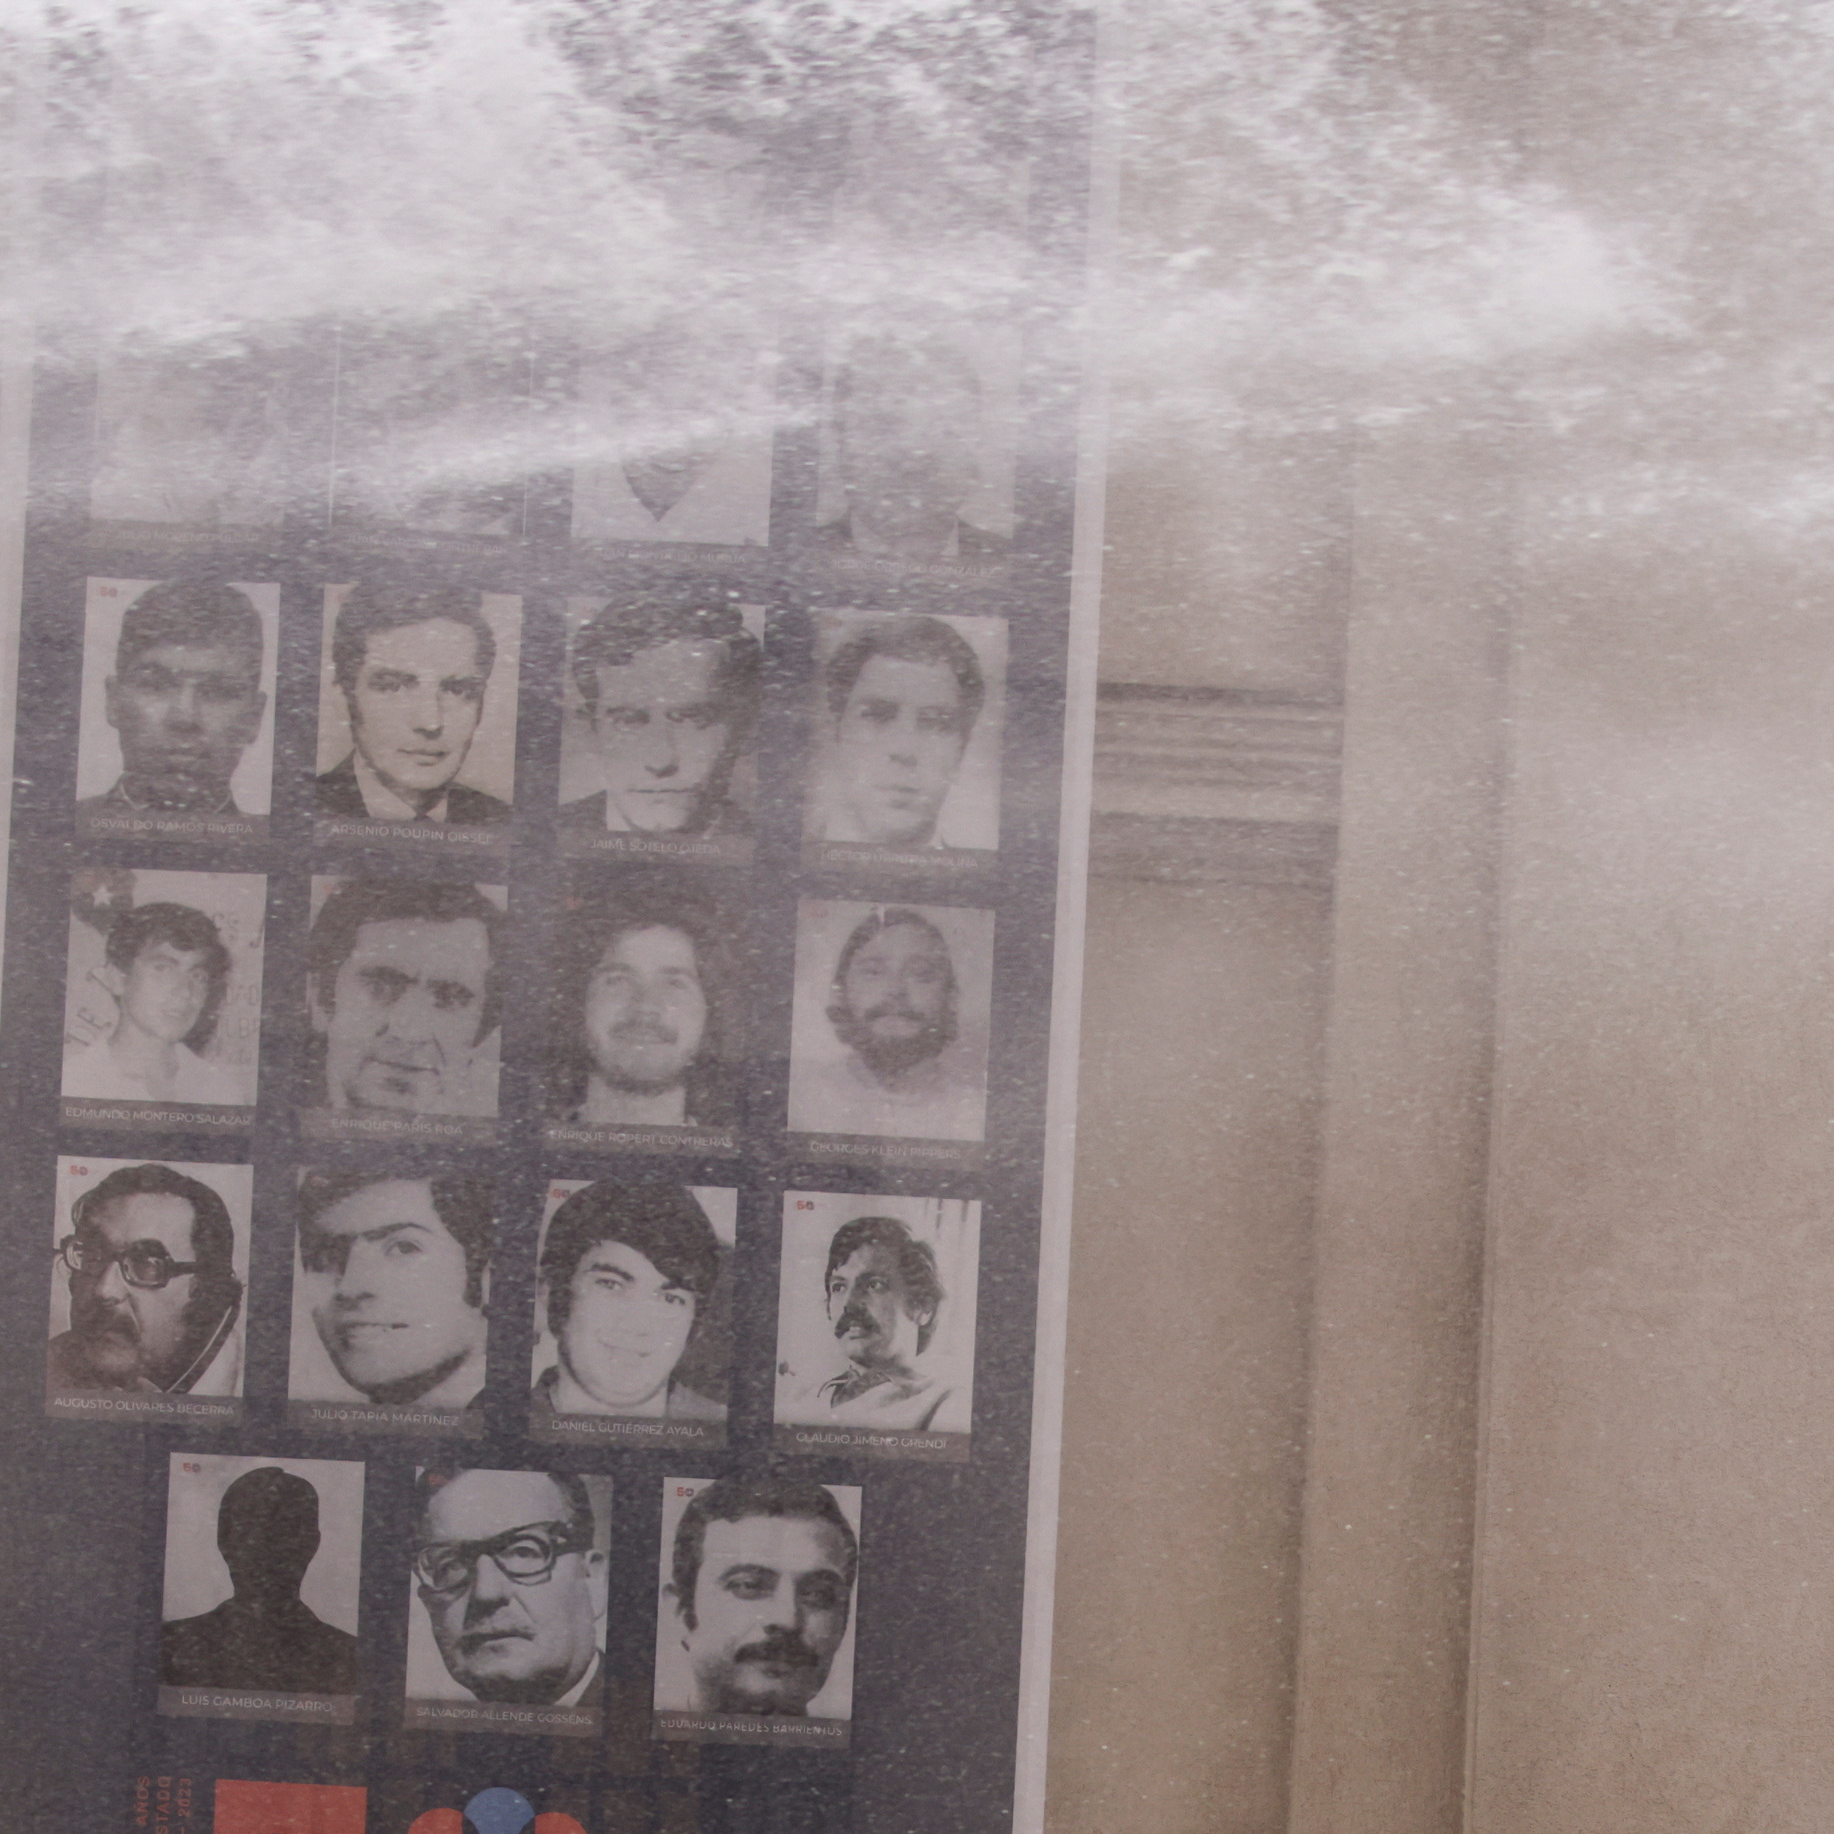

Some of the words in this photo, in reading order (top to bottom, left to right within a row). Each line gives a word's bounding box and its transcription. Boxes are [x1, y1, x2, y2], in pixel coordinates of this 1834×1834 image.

[91, 817, 153, 831] OSVALDO
[157, 820, 204, 833] RAMOS
[207, 822, 253, 834] RIVERA
[331, 824, 389, 837] ARSENIO
[393, 827, 444, 840] POUPIN
[590, 838, 625, 850] JAIME
[680, 843, 721, 855] OJEDA
[65, 1107, 130, 1120] EDMUNDO
[133, 1110, 194, 1122] MONTERO
[196, 1113, 251, 1125] SALAZAR
[331, 1118, 390, 1132] ENRIQUE
[435, 1124, 463, 1136] ROA
[549, 1129, 604, 1143] ENRIQUE
[609, 1132, 657, 1144] ROPERT
[660, 1135, 733, 1148] CONTRERAS
[810, 1141, 868, 1154] GEORGES
[871, 1144, 907, 1157] KLEIN
[54, 1397, 113, 1409] AUGUSTO
[116, 1399, 174, 1412] OLIVARES
[177, 1403, 234, 1415] BECERRA
[312, 1408, 348, 1420] JULIO
[351, 1410, 388, 1422] TAPIA
[552, 1420, 595, 1432] DANIEL
[666, 1425, 704, 1437] AYALA
[796, 1432, 850, 1445] CLAUDIO
[852, 1434, 898, 1447] JIMENO
[901, 1437, 947, 1449] GRENDI
[181, 1694, 210, 1706] LUIS
[213, 1696, 272, 1709] GAMBOA
[275, 1699, 332, 1712] PIZARRO
[416, 1707, 479, 1719] SALVADOR
[481, 1710, 534, 1722] ALLENDE
[537, 1712, 592, 1724] GOSSENS
[660, 1718, 716, 1732] EDUARDO
[719, 1721, 770, 1733] PAREDES
[772, 1724, 843, 1736] BARRIENTOS
[133, 1776, 151, 1826] AÑOS
[177, 1778, 192, 1817] 2023
